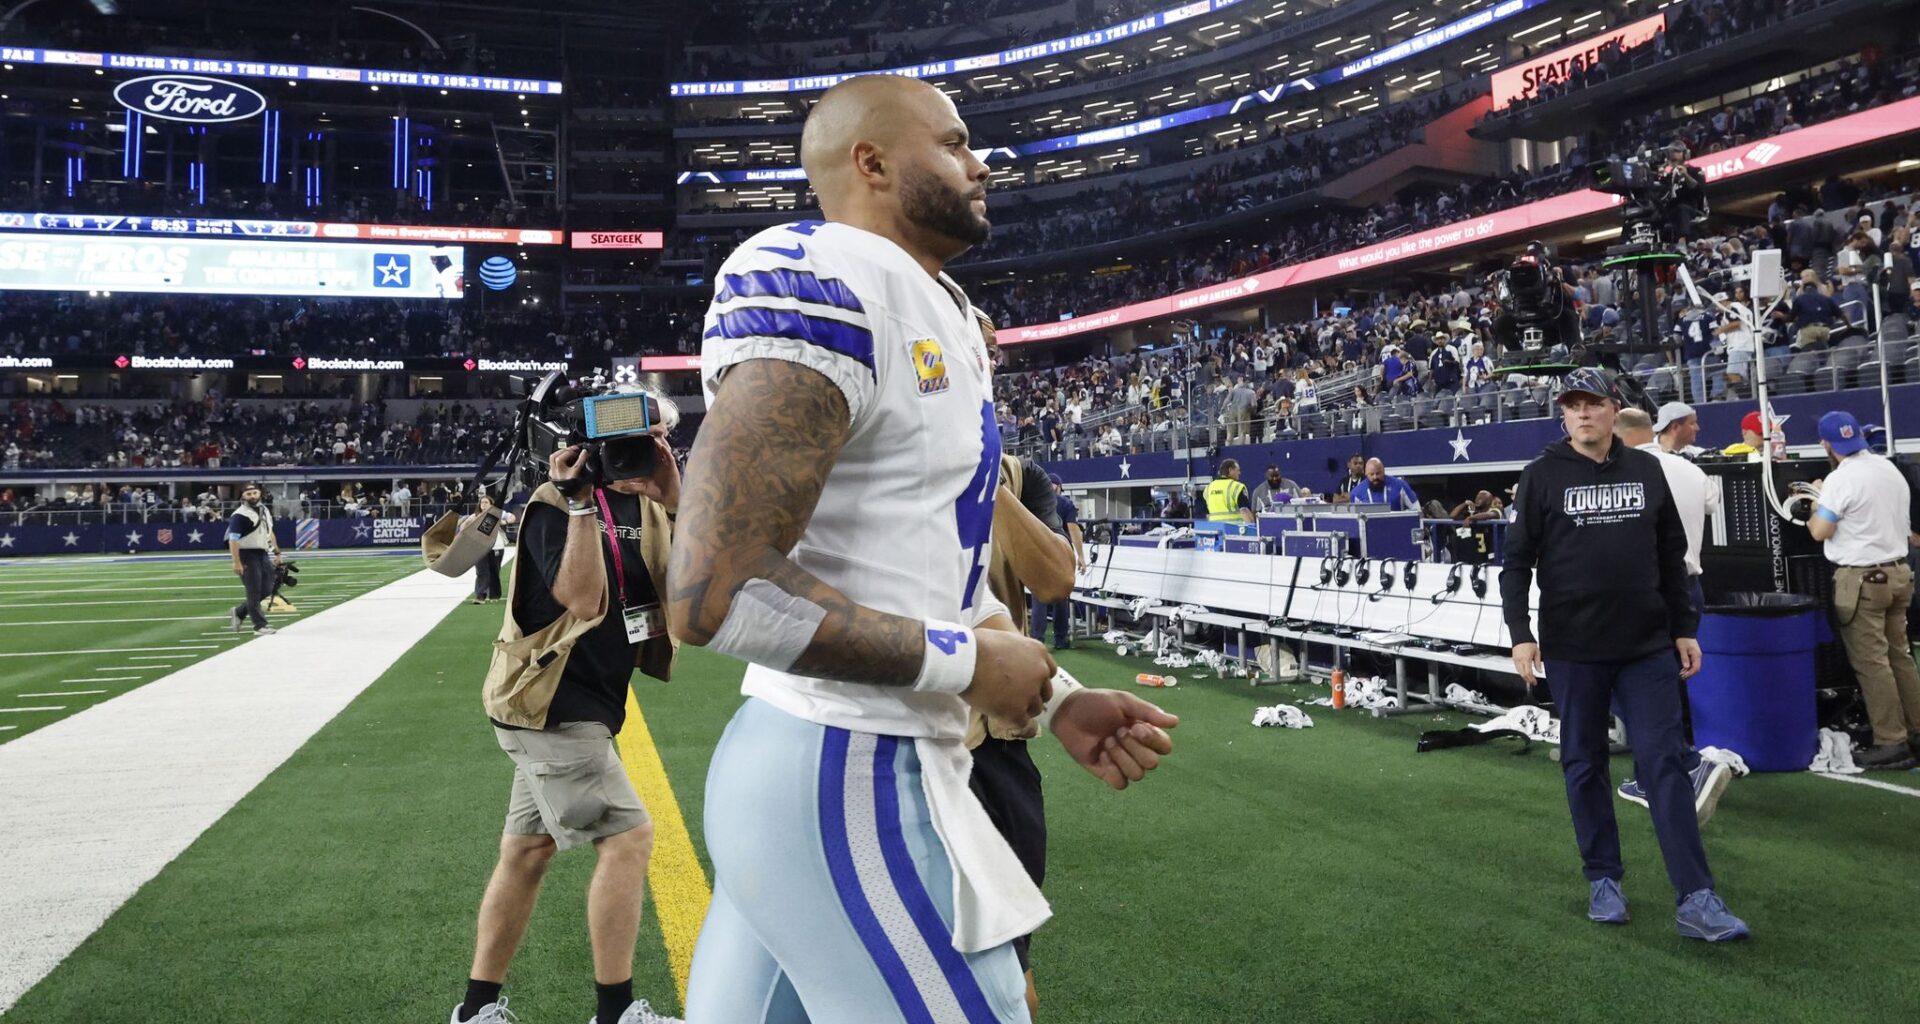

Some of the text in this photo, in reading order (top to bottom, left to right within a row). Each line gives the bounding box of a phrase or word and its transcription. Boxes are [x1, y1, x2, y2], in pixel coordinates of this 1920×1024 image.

[1005, 45, 1047, 62] LISTEN
[1051, 41, 1066, 51] TO
[1106, 27, 1128, 40] THE
[1132, 17, 1156, 33] FAN
[2, 49, 35, 61] FAN
[110, 55, 165, 69] LISTEN
[170, 60, 189, 70] TO
[237, 63, 265, 74] THE
[270, 65, 299, 77] FAN
[922, 63, 946, 75] FAN
[368, 71, 418, 84] LISTEN
[422, 74, 439, 85] TO
[484, 79, 509, 90] THE
[513, 81, 539, 92] FAN
[682, 84, 706, 94] THE
[710, 83, 735, 93] FAN
[795, 76, 838, 89] LISTEN
[144, 80, 237, 116] Ford
[1702, 157, 1744, 179] RICA
[591, 233, 643, 244] SEATGEEK
[1338, 219, 1495, 270] What would you like the power to do?
[79, 242, 191, 273] PROS
[0, 355, 52, 368] ain.com
[131, 356, 234, 369] Blockchain.com
[308, 358, 404, 370] Blockchain.com
[1567, 486, 1642, 512] COWBOYS
[373, 518, 420, 528] CRUCIAL
[373, 528, 409, 538] CATCH
[1475, 533, 1487, 553] 3
[1770, 513, 1784, 577] TECHNOLOGY
[927, 629, 969, 656] 4
[1334, 683, 1342, 692] G
